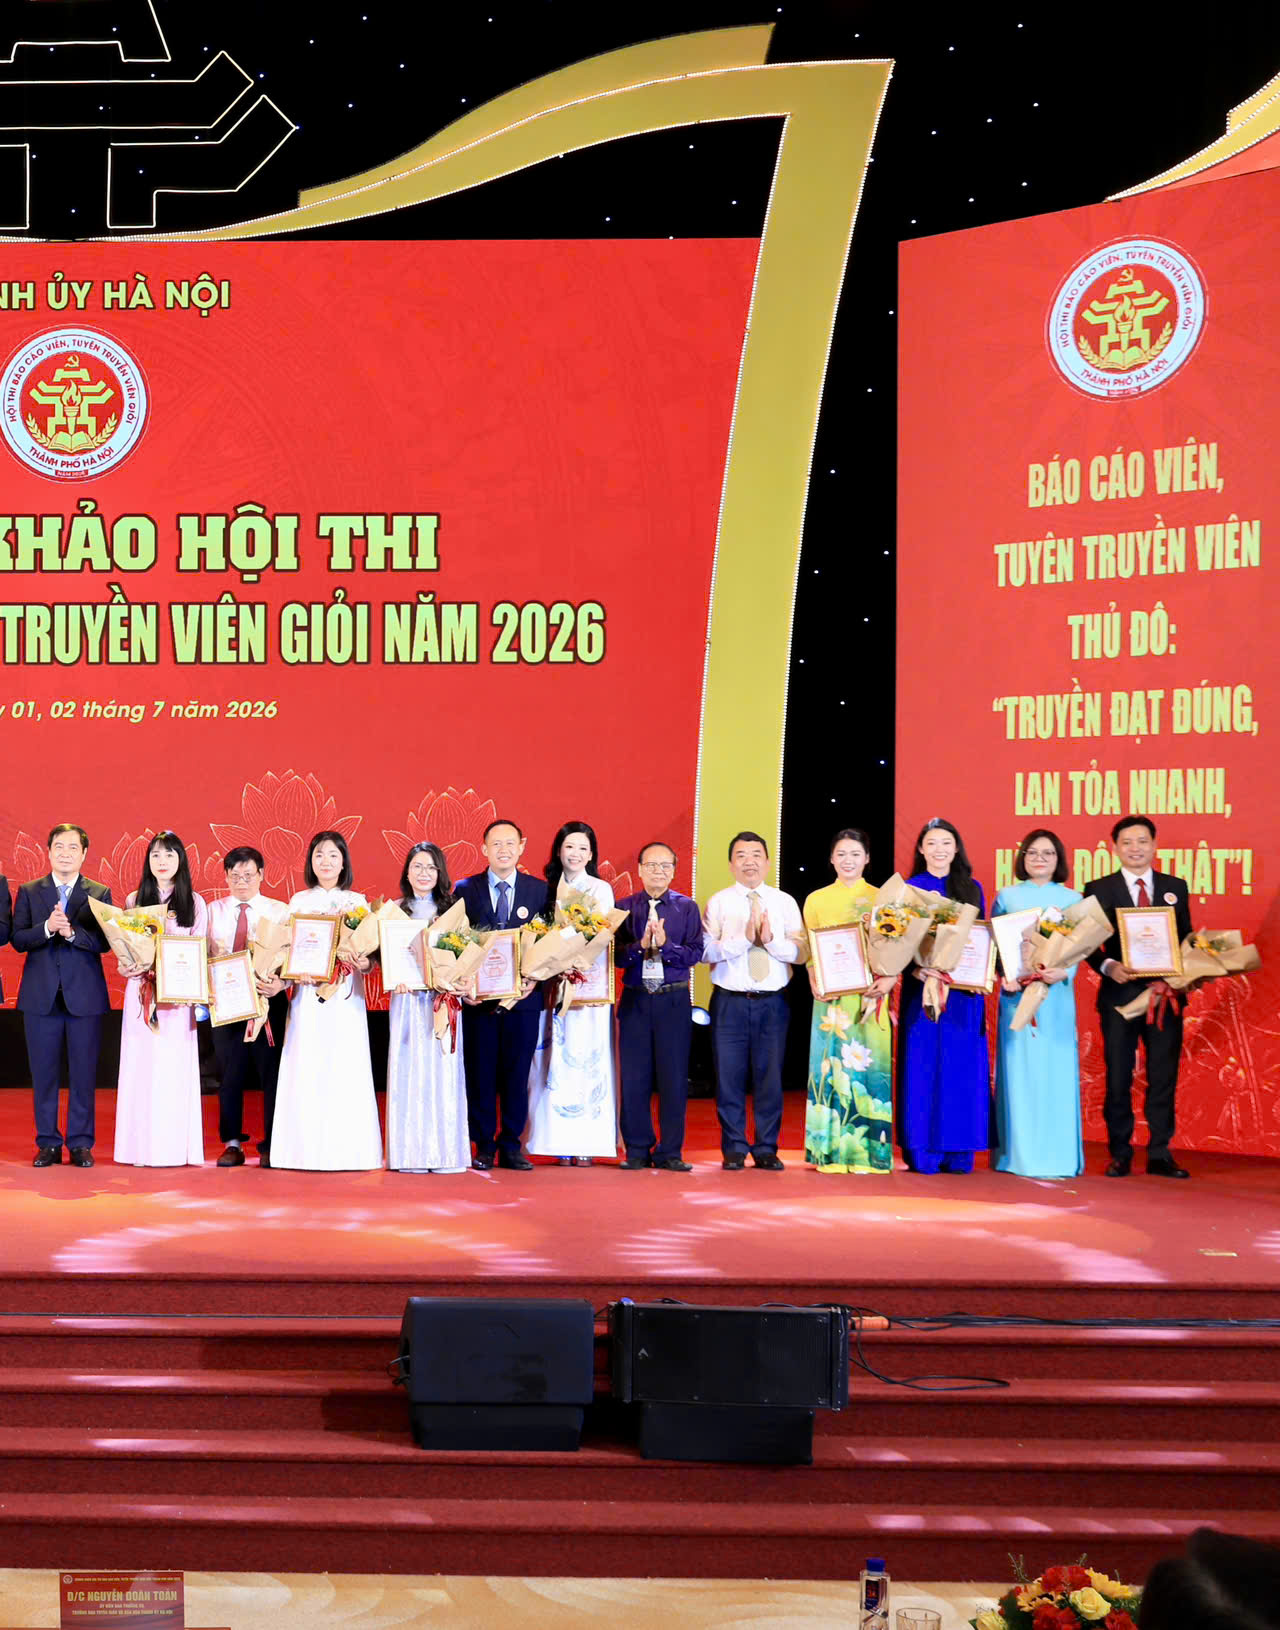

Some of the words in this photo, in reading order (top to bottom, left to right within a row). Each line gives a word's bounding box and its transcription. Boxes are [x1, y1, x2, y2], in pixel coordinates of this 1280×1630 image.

[48, 273, 91, 309] ỦY
[105, 274, 153, 308] HÀ
[167, 273, 228, 316] NỘI
[25, 347, 44, 366] CÁO
[72, 339, 100, 352] TUYÊN
[12, 366, 26, 385] BÁO
[102, 348, 129, 377] TRUYỀN
[8, 387, 17, 402] THI
[123, 378, 137, 399] VIÊN
[6, 405, 17, 423] HỘI
[126, 402, 137, 424] GIỎI
[29, 446, 58, 468] THÀNH
[60, 457, 81, 469] PHỐ
[83, 455, 97, 468] HÀ
[98, 446, 115, 461] NỘI
[1029, 455, 1080, 507] BÁO
[1090, 447, 1144, 501] CÁO
[1154, 437, 1224, 494] VIÊN,
[179, 503, 298, 581] HỘI
[318, 515, 438, 570] THI
[994, 532, 1073, 587] TUYÊN
[1082, 514, 1185, 580] TRUYỀN
[1195, 514, 1260, 570] VIÊN
[0, 585, 156, 663] TRUYỀN
[172, 594, 264, 662] VIÊN
[282, 589, 367, 663] GIỎI
[385, 594, 476, 662] NĂM
[493, 603, 603, 662] 2026
[1068, 602, 1120, 659] THỦ
[1129, 601, 1176, 656] ĐÔ:
[12, 701, 41, 721] 01,
[51, 701, 76, 718] 02
[83, 700, 145, 723] tháng
[153, 701, 164, 718] 7
[172, 700, 218, 718] năm
[226, 701, 277, 718] 2026
[1110, 690, 1164, 744] ĐẠT
[1172, 680, 1258, 736] ĐÚNG,
[1015, 772, 1060, 815] LAN
[1069, 759, 1121, 815] TỎA
[1130, 768, 1232, 818] NHANH,
